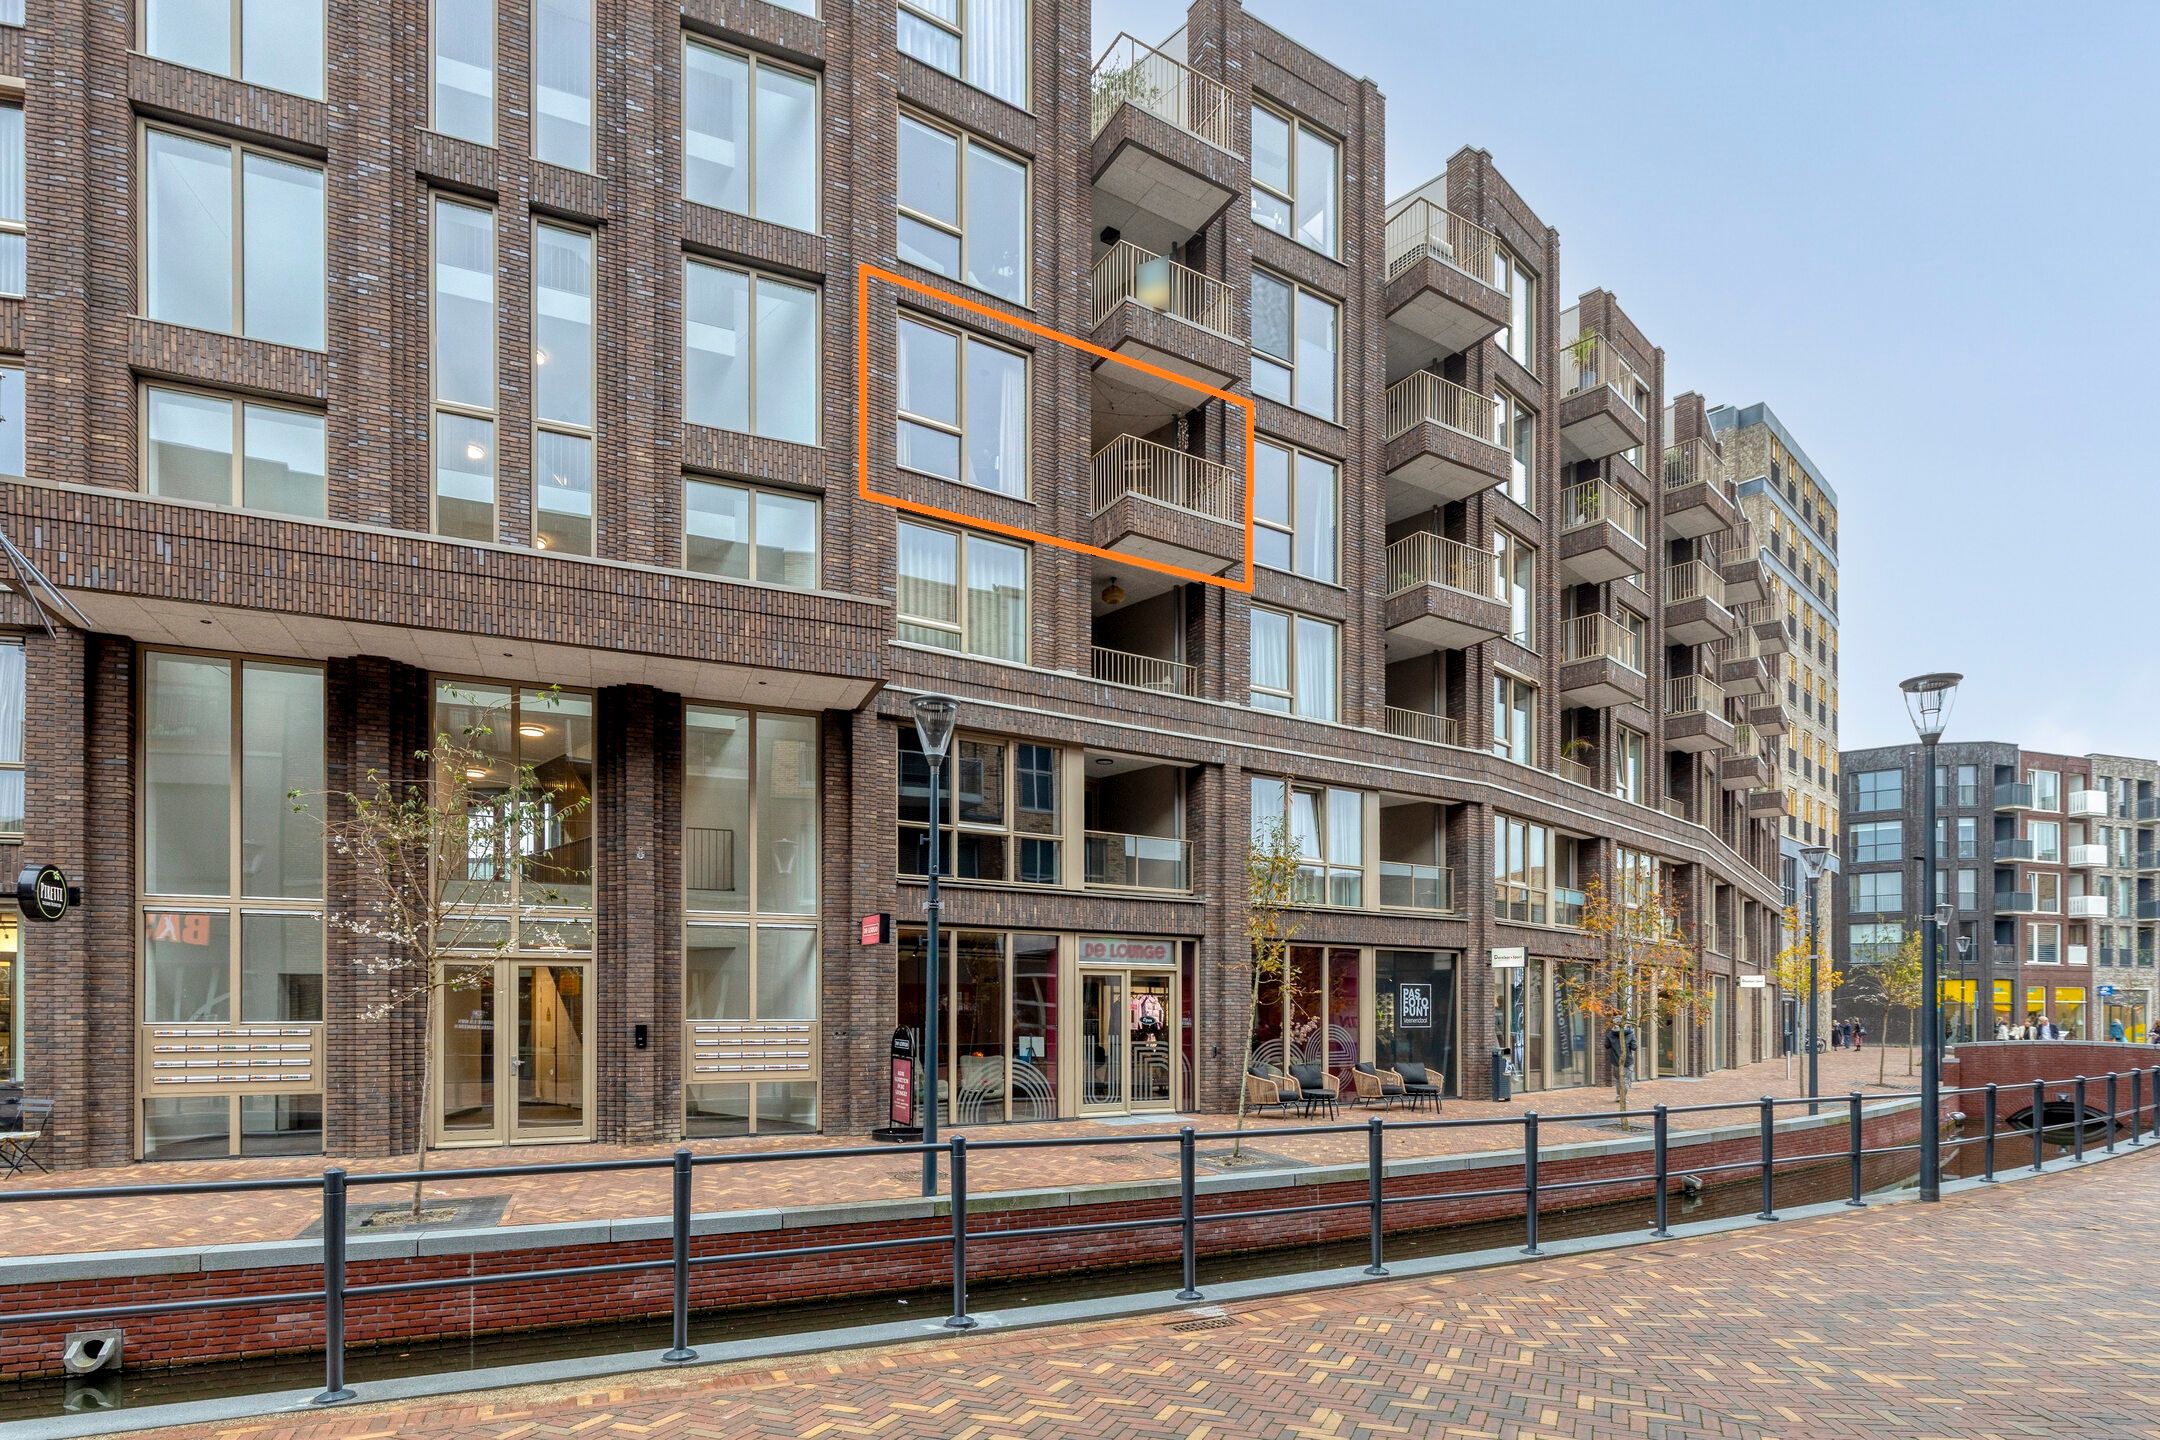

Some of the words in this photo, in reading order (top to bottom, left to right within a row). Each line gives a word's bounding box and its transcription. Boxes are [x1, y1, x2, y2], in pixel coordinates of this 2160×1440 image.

[1403, 988, 1421, 999] PAS
[1403, 997, 1429, 1008] FOTO
[1403, 1006, 1430, 1017] PUNT
